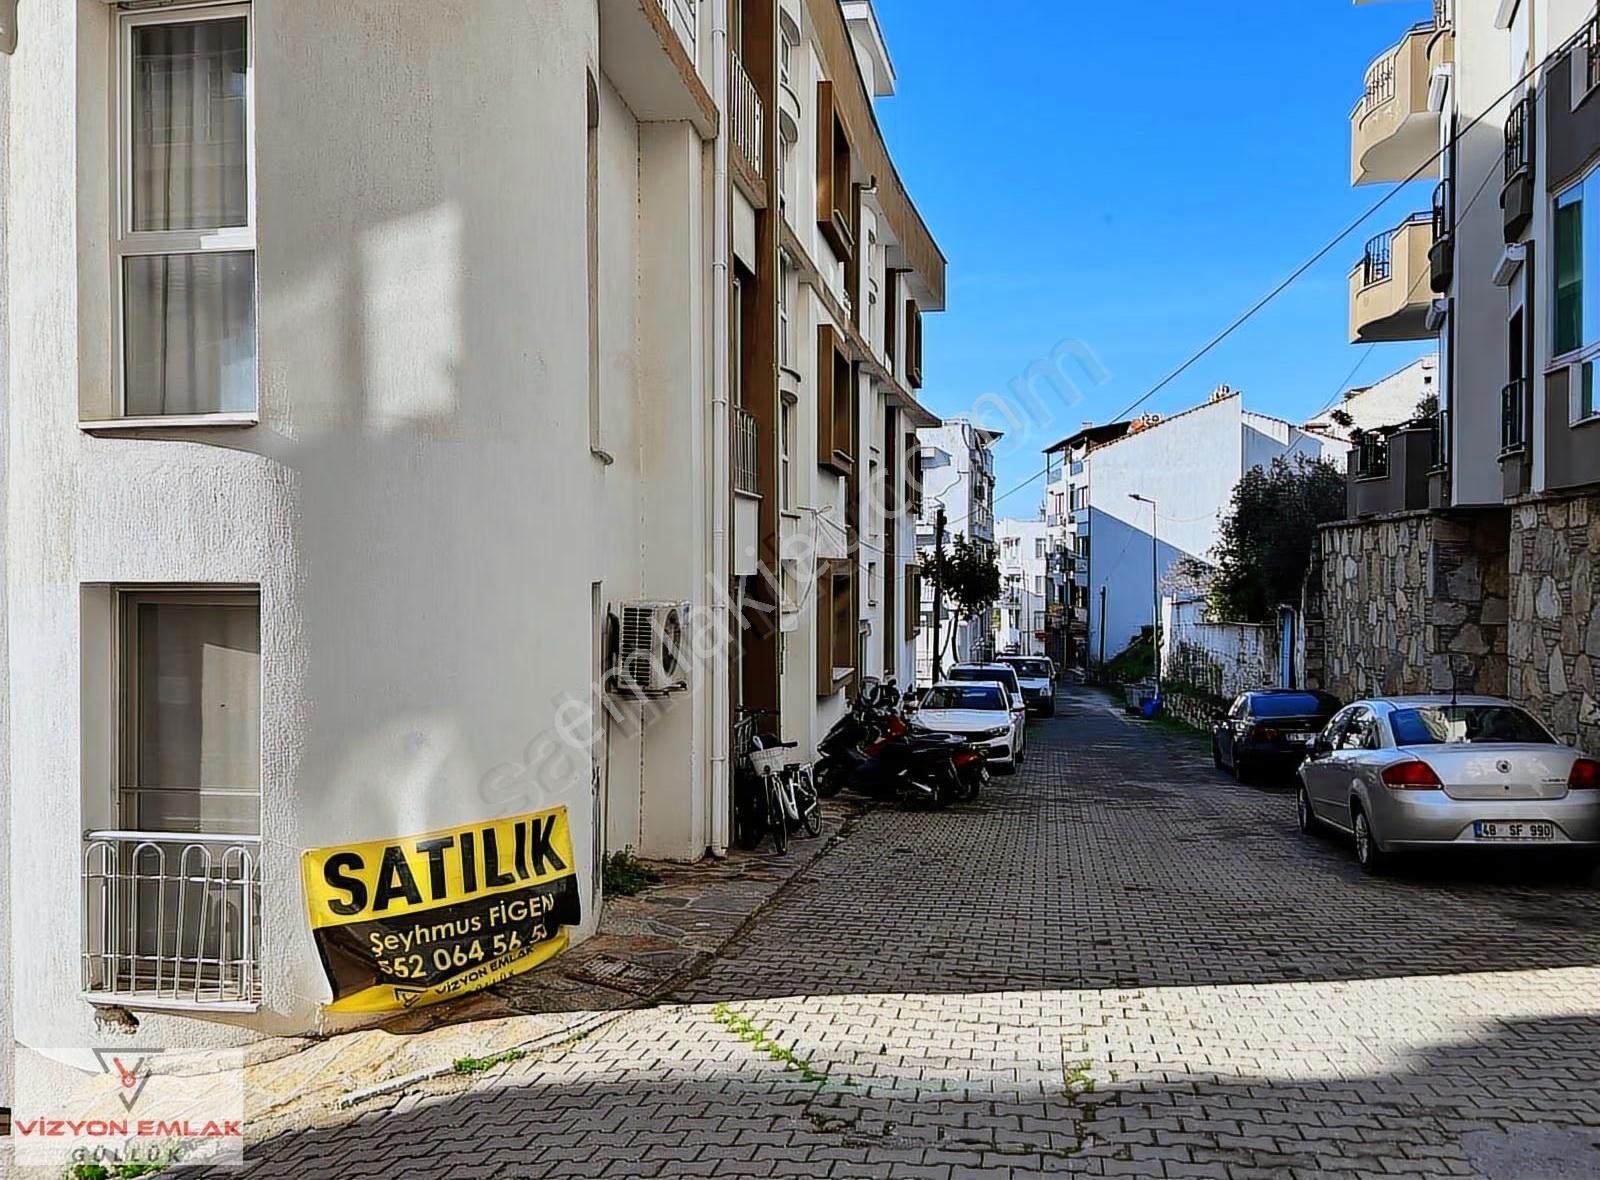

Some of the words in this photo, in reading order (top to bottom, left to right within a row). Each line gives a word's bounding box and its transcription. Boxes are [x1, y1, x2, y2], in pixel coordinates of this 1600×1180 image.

[1509, 824, 1523, 836] SF
[1530, 824, 1551, 836] 990
[322, 814, 567, 916] SATILIK
[369, 915, 482, 957] Şeyhmus
[489, 893, 554, 927] FİGEN
[433, 939, 485, 971] 064
